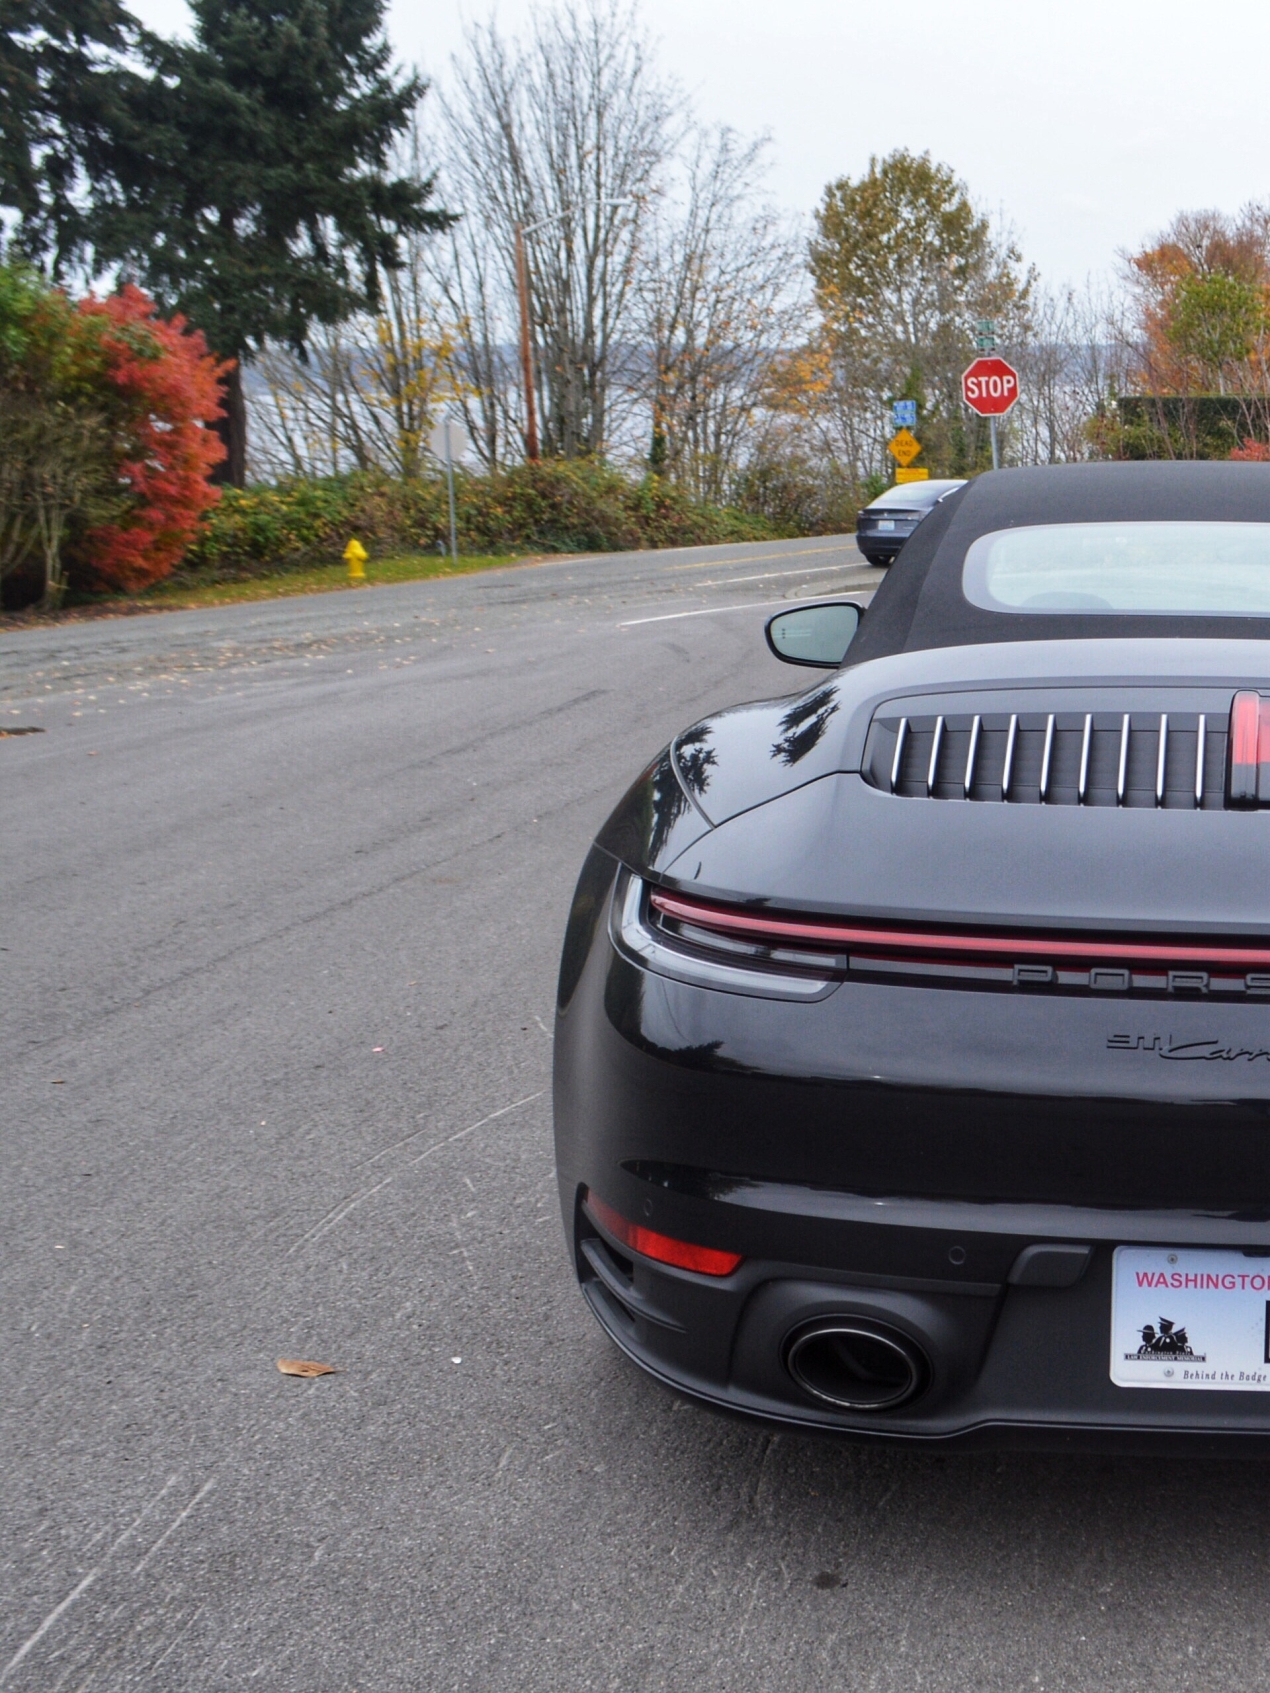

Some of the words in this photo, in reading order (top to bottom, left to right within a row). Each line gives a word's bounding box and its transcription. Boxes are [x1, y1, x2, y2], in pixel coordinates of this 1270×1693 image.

[966, 375, 1015, 399] STOP
[898, 449, 912, 457] END
[1106, 1034, 1172, 1051] 911
[1183, 1370, 1217, 1380] Behind
[1220, 1371, 1235, 1381] the
[1239, 1371, 1267, 1383] Badge
